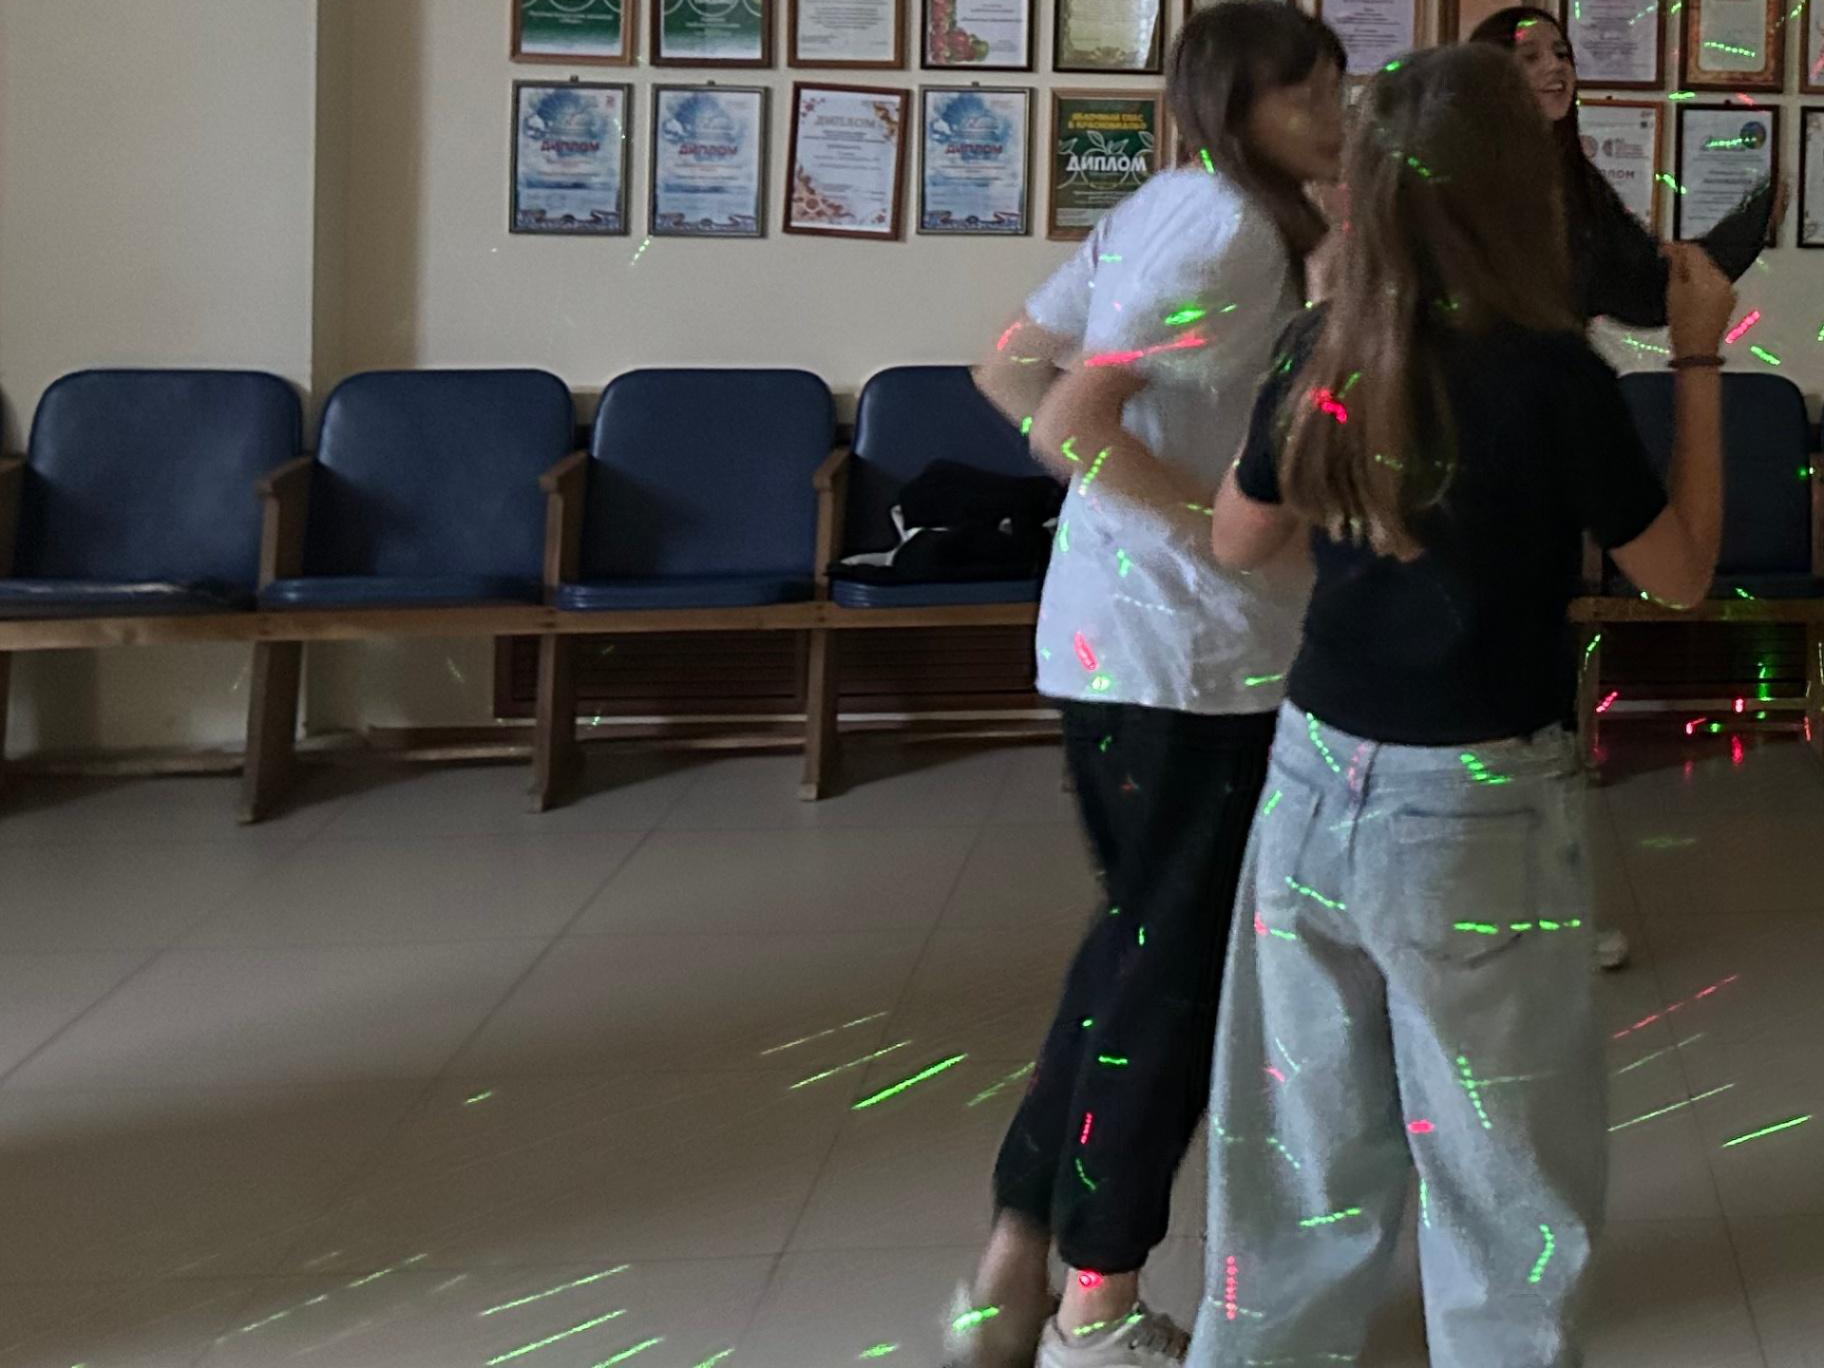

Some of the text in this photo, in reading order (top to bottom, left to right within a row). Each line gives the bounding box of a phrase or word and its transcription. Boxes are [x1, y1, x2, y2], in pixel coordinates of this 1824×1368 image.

[814, 115, 877, 130] ДИПЛОМ
[540, 140, 600, 153] ДИПЛОМ
[679, 143, 738, 156] ДИПЛОМ
[945, 143, 1003, 155] ДИПЛОМ
[1065, 155, 1147, 172] ДИПЛОМ
